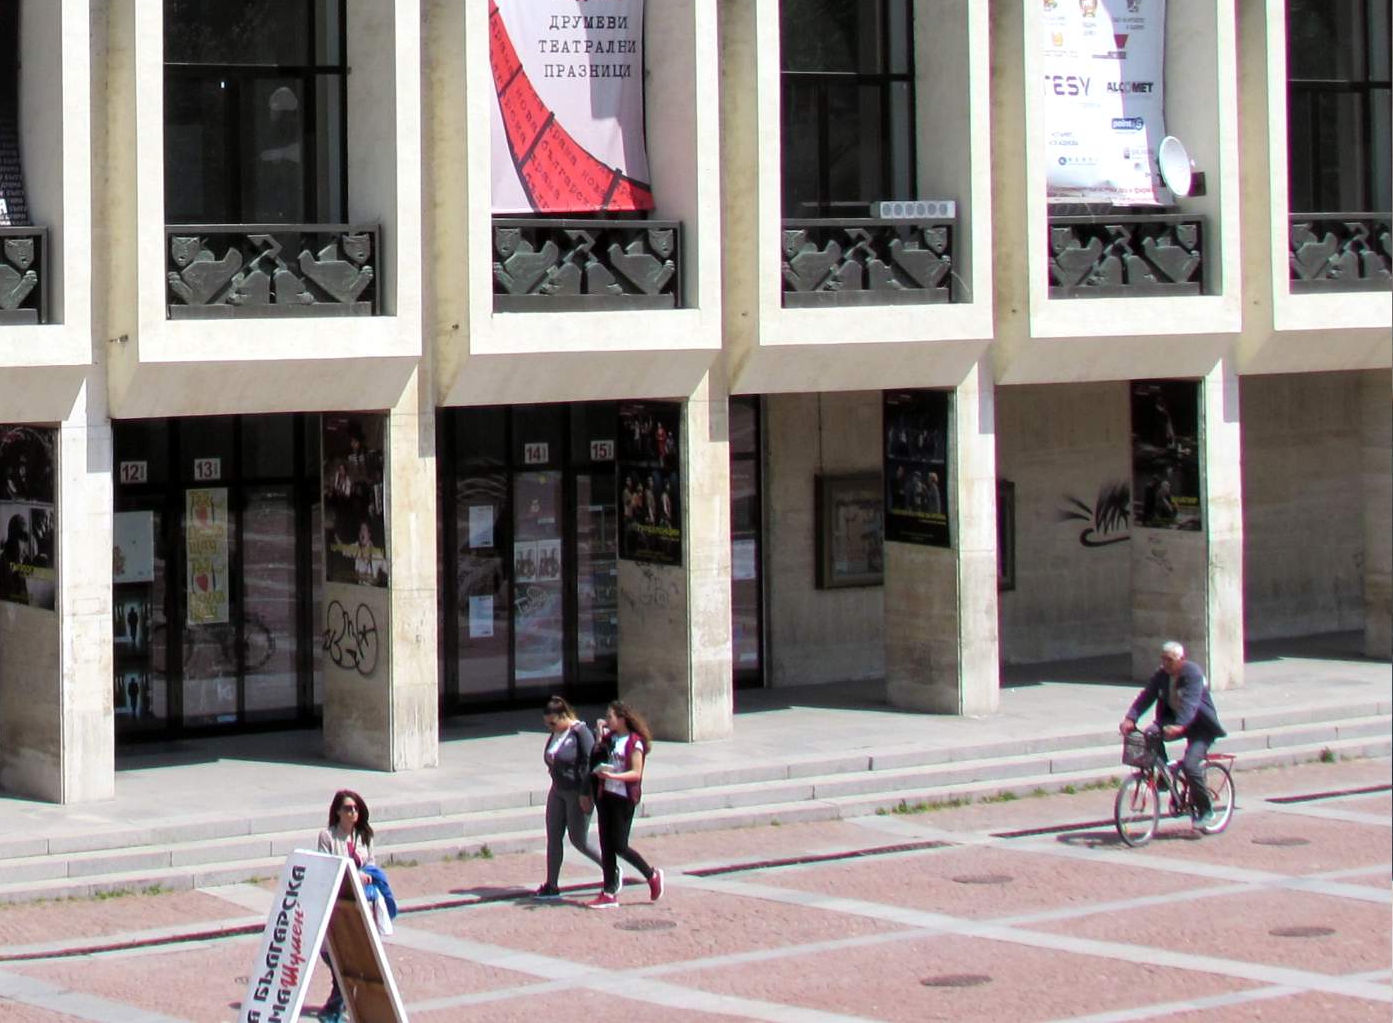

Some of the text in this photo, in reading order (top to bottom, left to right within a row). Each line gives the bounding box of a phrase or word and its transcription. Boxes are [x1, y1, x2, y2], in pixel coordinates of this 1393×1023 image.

[548, 15, 628, 31] ДРУМЕВИ
[538, 39, 636, 53] ТЕАТРАЛНИ
[544, 63, 632, 79] ПРАЗНИЦИ
[1106, 81, 1154, 93] ALCOMET
[526, 445, 540, 461] 14
[592, 443, 608, 459] 15
[122, 463, 139, 481] 12
[196, 461, 214, 478] 13
[254, 865, 306, 1003] БЪЛГАРСКА
